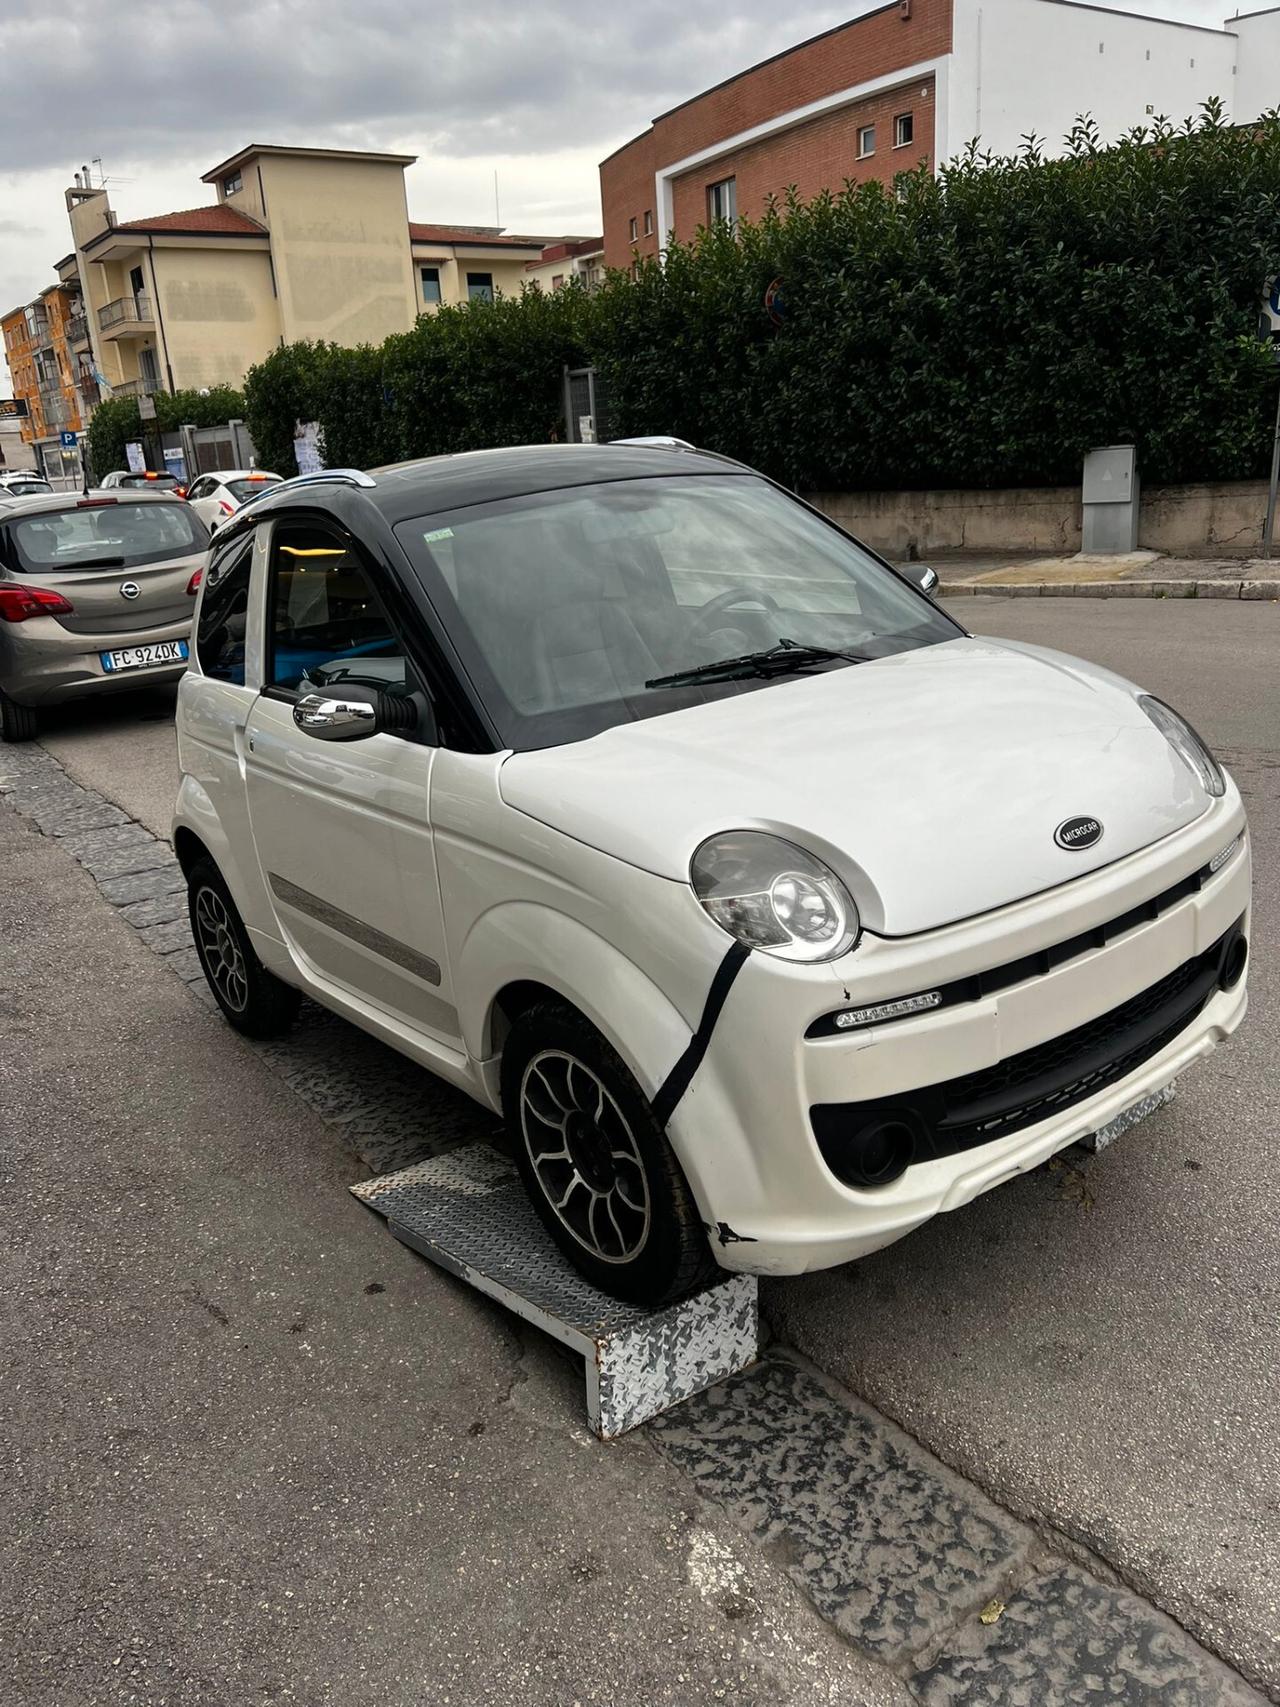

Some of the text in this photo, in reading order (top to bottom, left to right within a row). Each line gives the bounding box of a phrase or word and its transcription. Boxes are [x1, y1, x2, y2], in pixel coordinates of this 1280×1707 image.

[64, 433, 73, 444] P
[112, 651, 131, 667] FC
[135, 643, 179, 663] 924DK
[1062, 821, 1099, 843] MICROCAR
